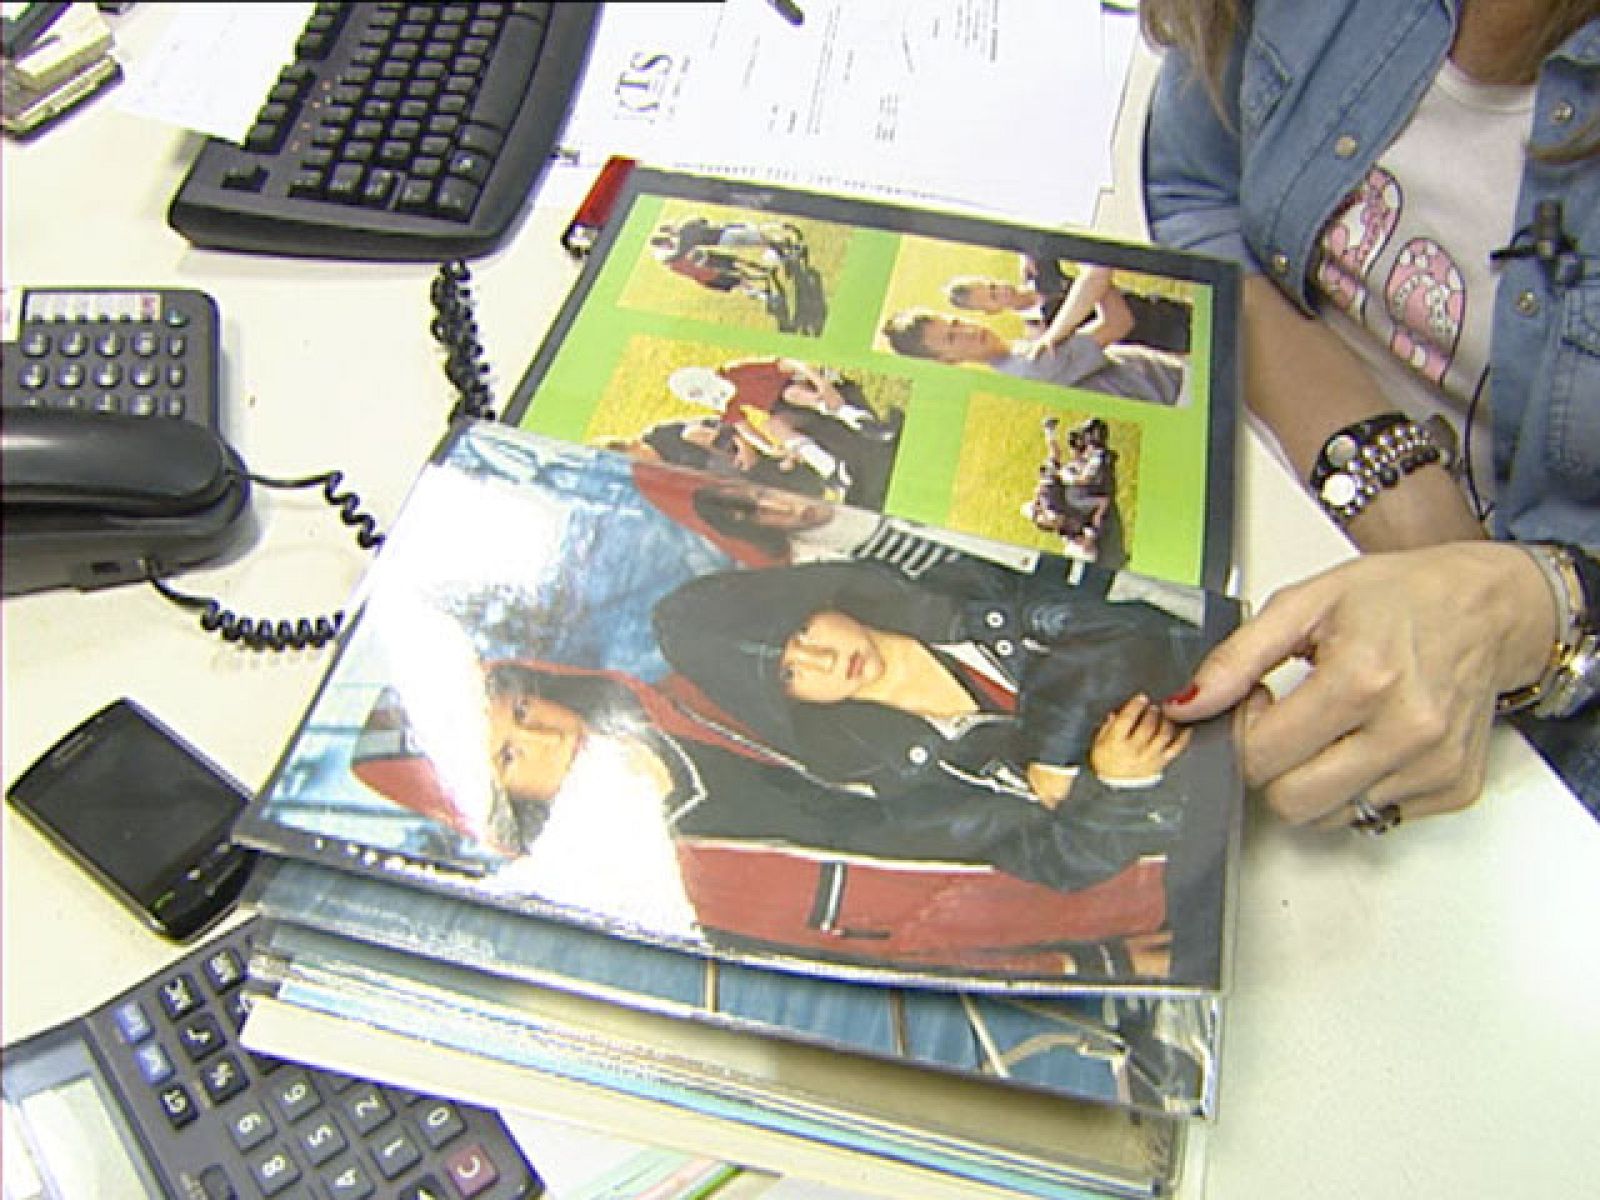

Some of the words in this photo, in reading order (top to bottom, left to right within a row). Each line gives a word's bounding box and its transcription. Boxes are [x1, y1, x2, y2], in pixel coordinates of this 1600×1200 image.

[283, 1082, 306, 1105] 6
[355, 1094, 379, 1118] 2
[427, 1107, 449, 1126] 0
[237, 1112, 261, 1134] 9
[307, 1124, 333, 1148] 5
[384, 1139, 403, 1157] 1
[262, 1154, 286, 1178] 8
[456, 1155, 481, 1178] C
[334, 1168, 356, 1188] 4
